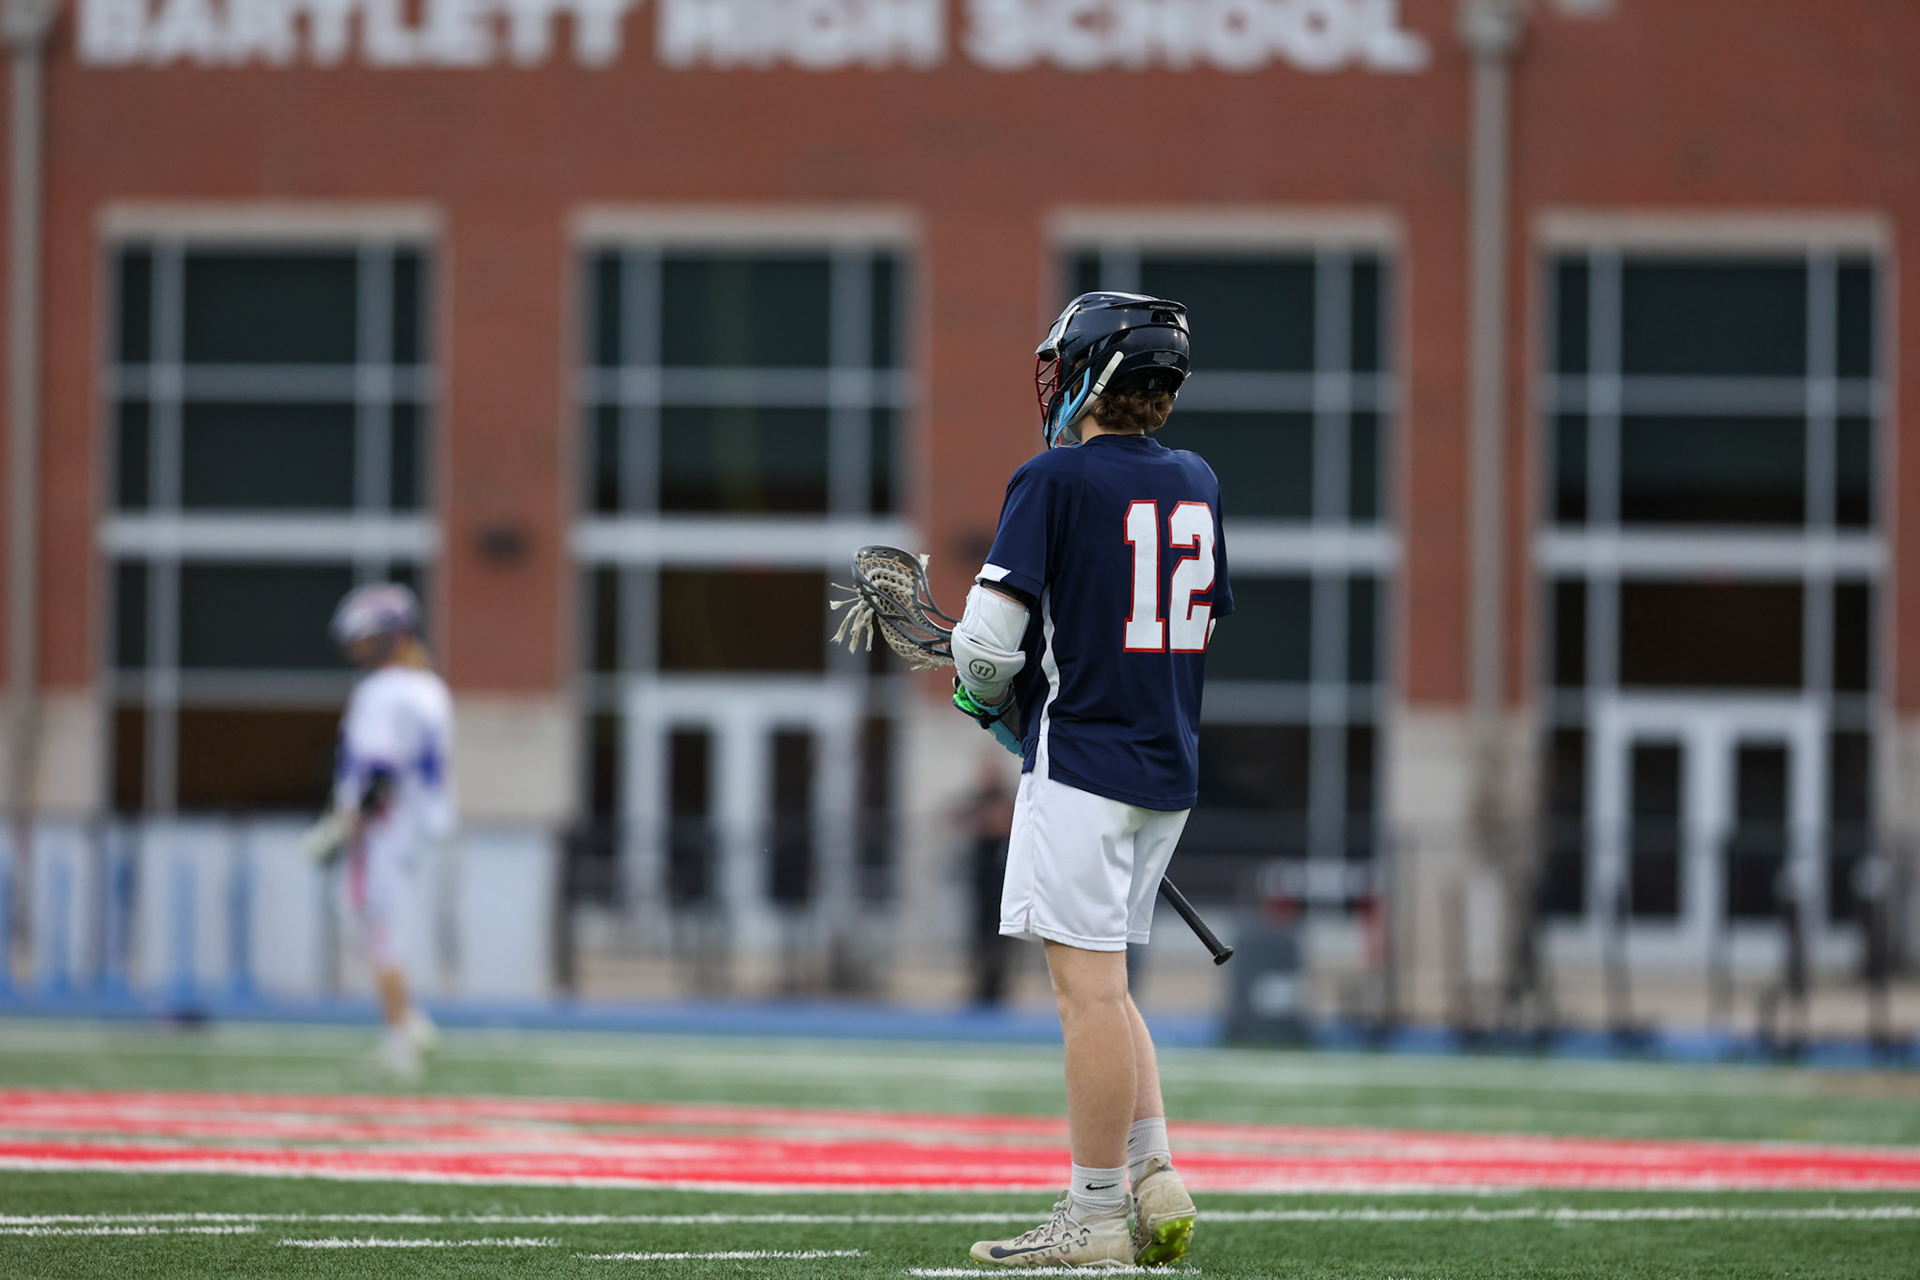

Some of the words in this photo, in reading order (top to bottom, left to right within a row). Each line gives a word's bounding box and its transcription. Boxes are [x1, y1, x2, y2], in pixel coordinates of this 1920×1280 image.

[76, 0, 628, 66] BARTLETT
[657, 0, 945, 69] HIGH
[966, 0, 1428, 70] SCHOOL
[1123, 500, 1215, 653] 12
